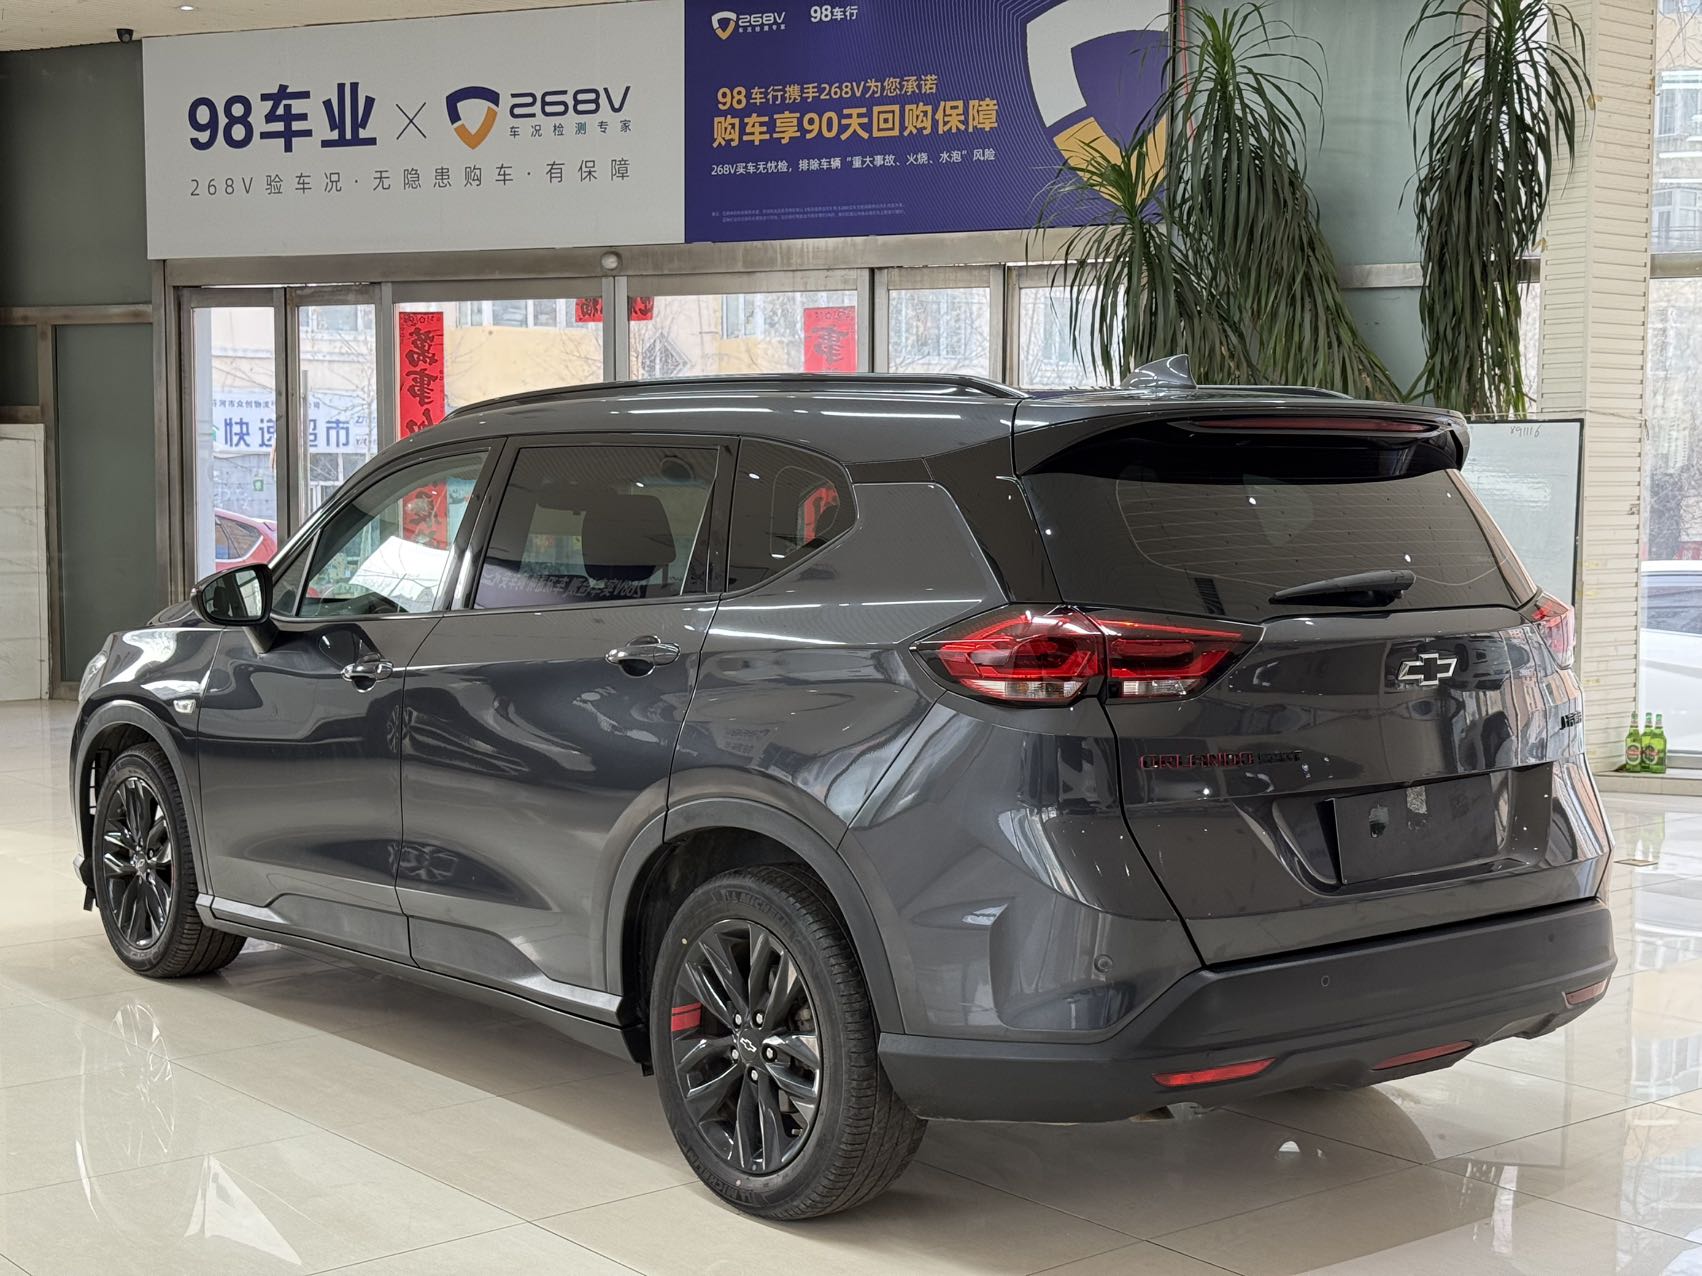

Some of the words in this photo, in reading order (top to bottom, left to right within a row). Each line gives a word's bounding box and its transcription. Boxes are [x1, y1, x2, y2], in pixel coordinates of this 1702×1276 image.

[738, 12, 786, 26] 268V
[809, 4, 859, 23] 98车行
[508, 85, 632, 119] 268V
[188, 82, 378, 153] 98车业
[508, 119, 633, 138] 车况检测专家
[712, 98, 999, 149] 购车享90天回购保障
